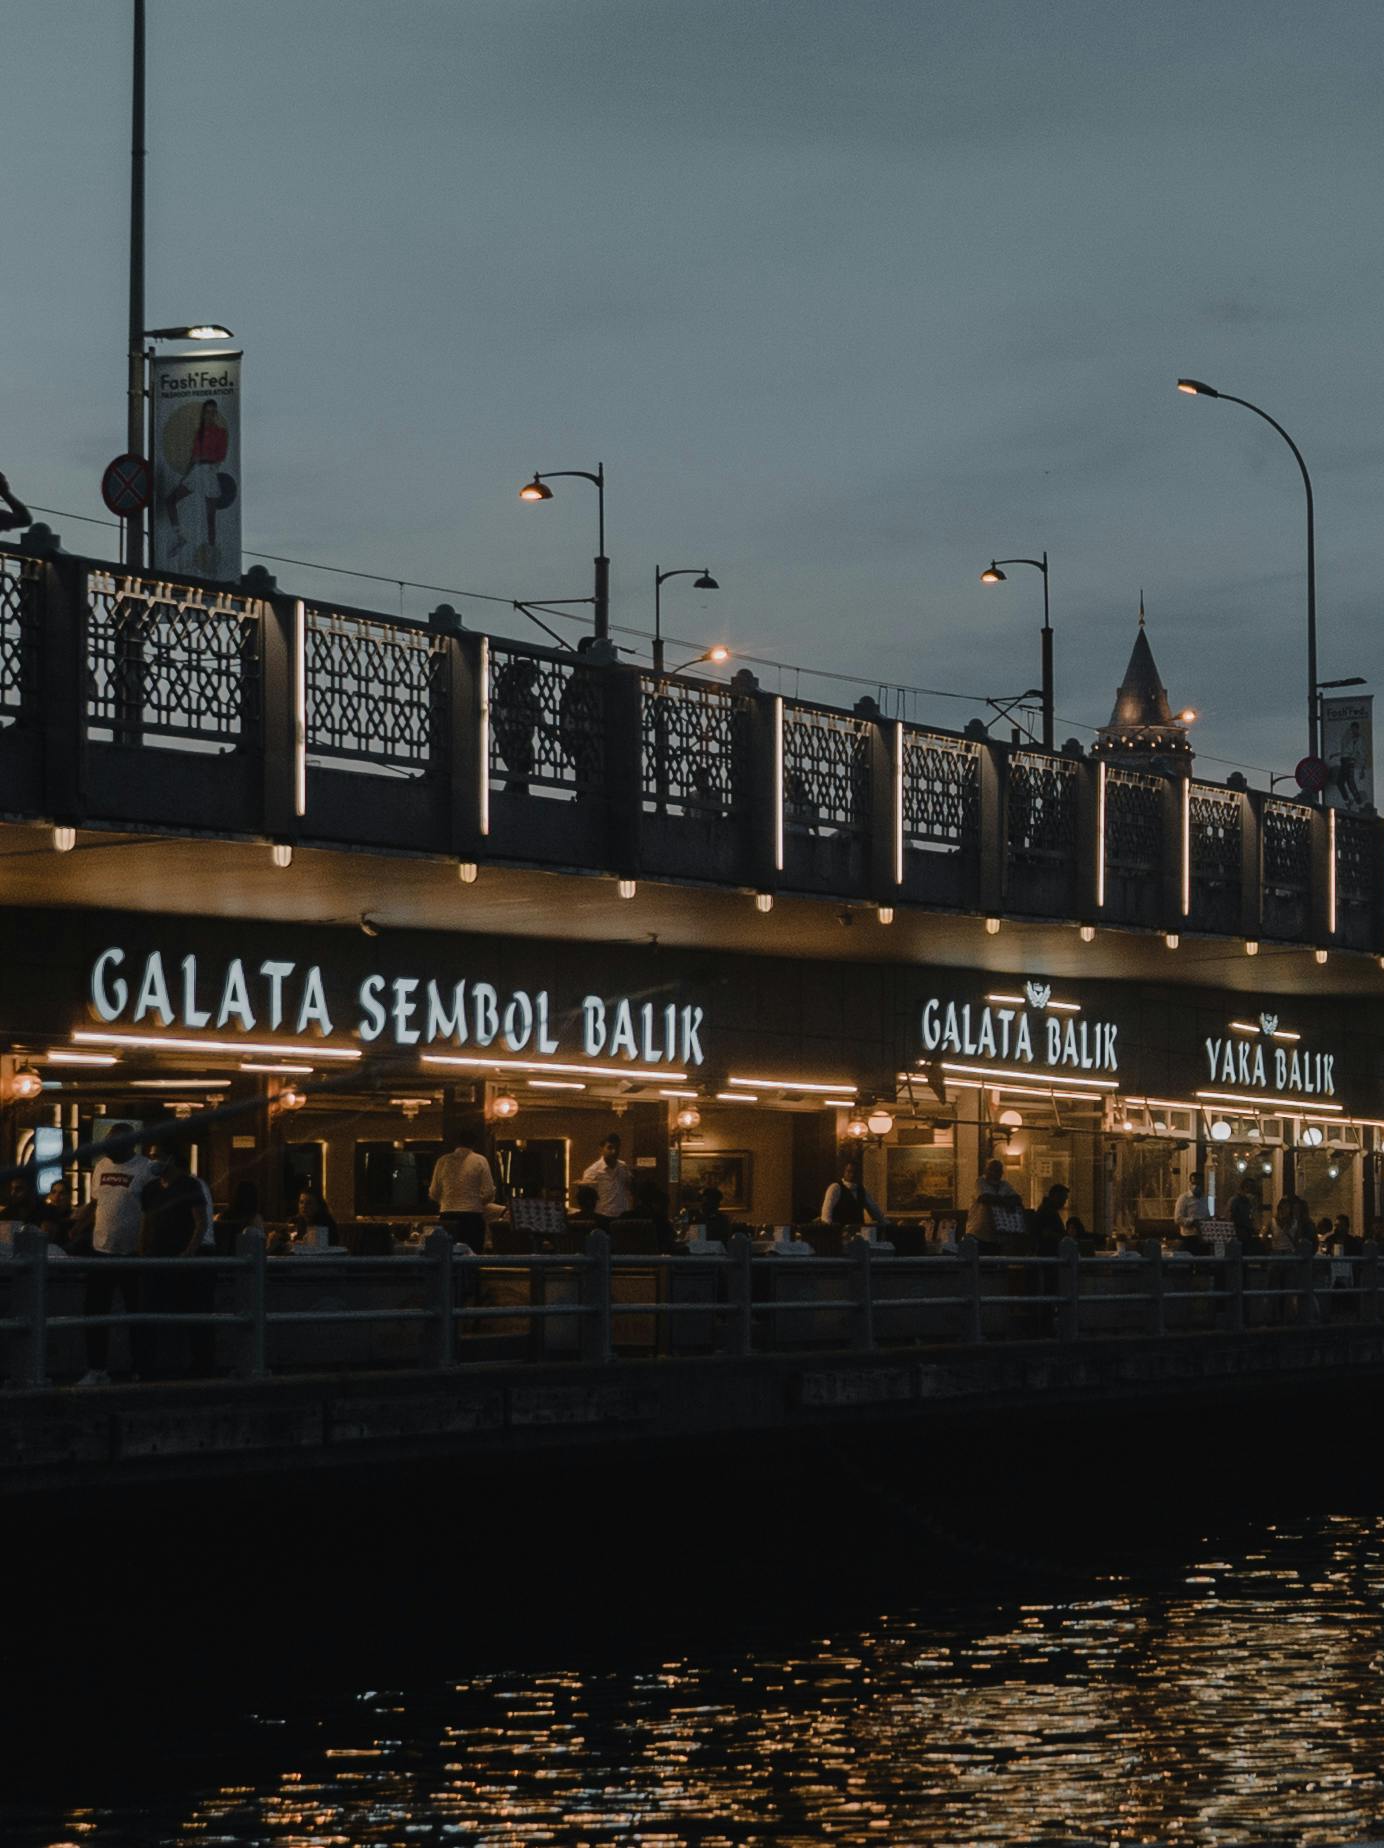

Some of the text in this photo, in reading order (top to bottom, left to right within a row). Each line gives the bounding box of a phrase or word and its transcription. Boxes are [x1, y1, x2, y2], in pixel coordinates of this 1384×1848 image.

[90, 947, 706, 1066] GALATA SEMBOL BALIK
[921, 998, 1118, 1072] GALATA BALIK
[1205, 1037, 1335, 1096] YAKA BALIK
